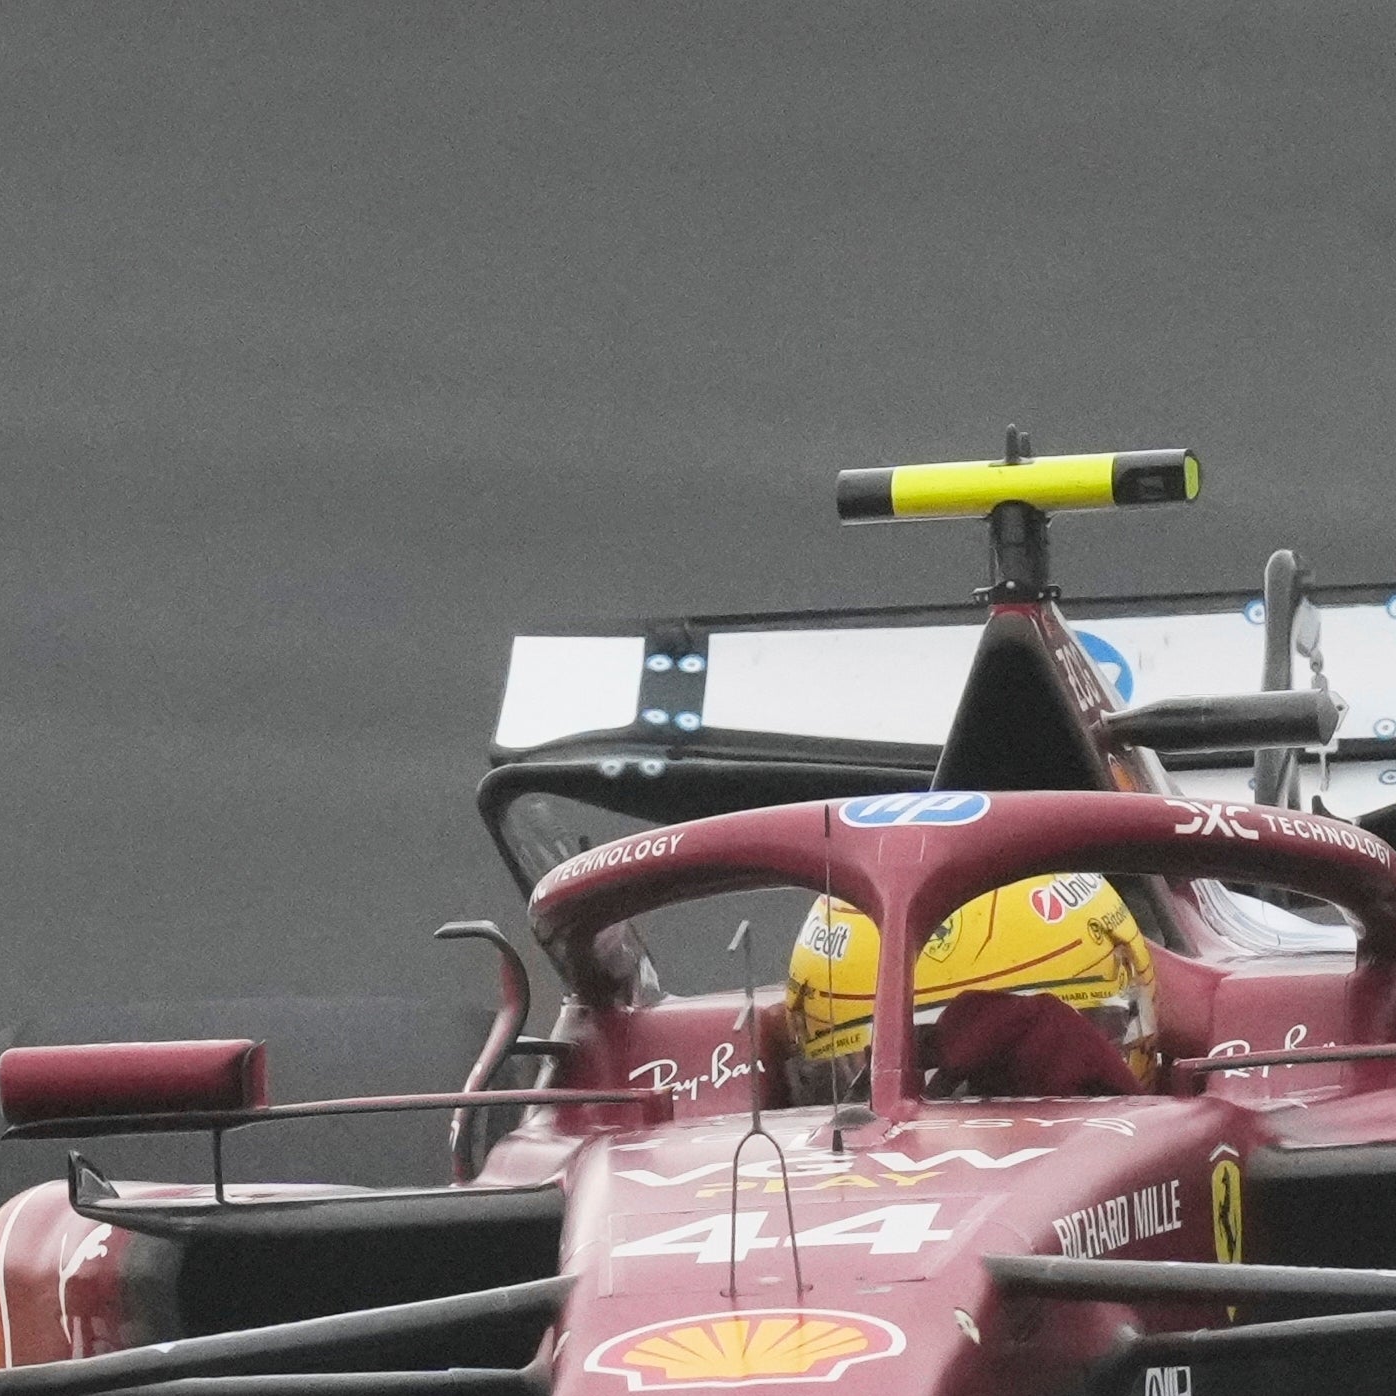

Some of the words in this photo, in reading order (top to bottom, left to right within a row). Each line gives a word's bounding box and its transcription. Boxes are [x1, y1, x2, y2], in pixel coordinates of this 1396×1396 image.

[854, 794, 978, 826] hp
[1164, 799, 1259, 840] DXC
[1263, 814, 1391, 870] TECHNOLOGY
[555, 833, 684, 884] TECHNOLOGY
[613, 1147, 1056, 1187] VGW
[695, 1172, 945, 1198] PLAY
[610, 1203, 953, 1264] 44
[1052, 1196, 1129, 1259] RICHARD
[1134, 1180, 1181, 1240] MILLE
